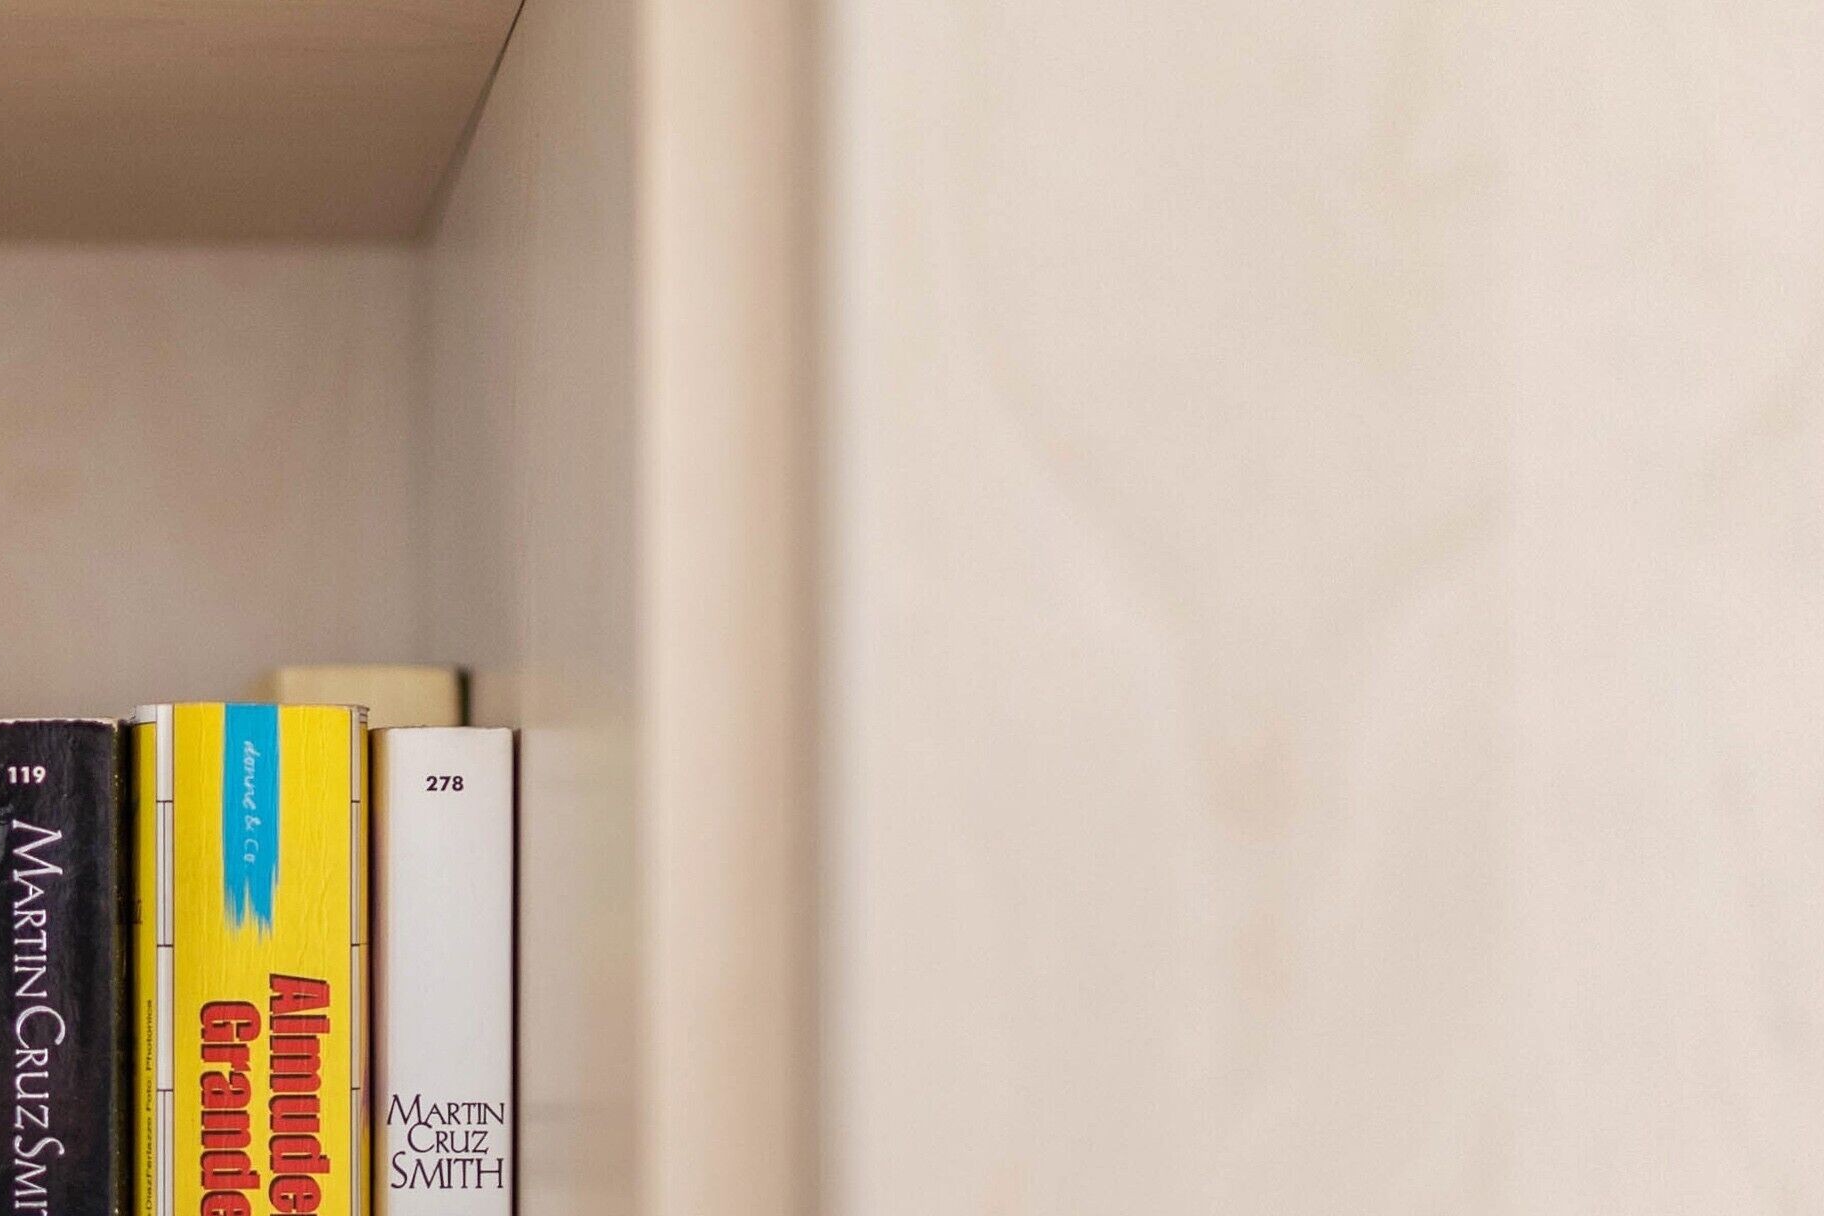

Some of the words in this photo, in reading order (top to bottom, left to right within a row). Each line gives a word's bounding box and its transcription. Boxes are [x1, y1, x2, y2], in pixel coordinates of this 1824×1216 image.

[7, 765, 46, 784] 119
[426, 775, 464, 792] 278
[12, 820, 64, 998] MARTIN
[14, 1005, 66, 1130] CRUZ
[386, 1094, 505, 1125] MARTIN
[407, 1122, 489, 1155] CRUZ
[390, 1151, 504, 1190] SMITH
